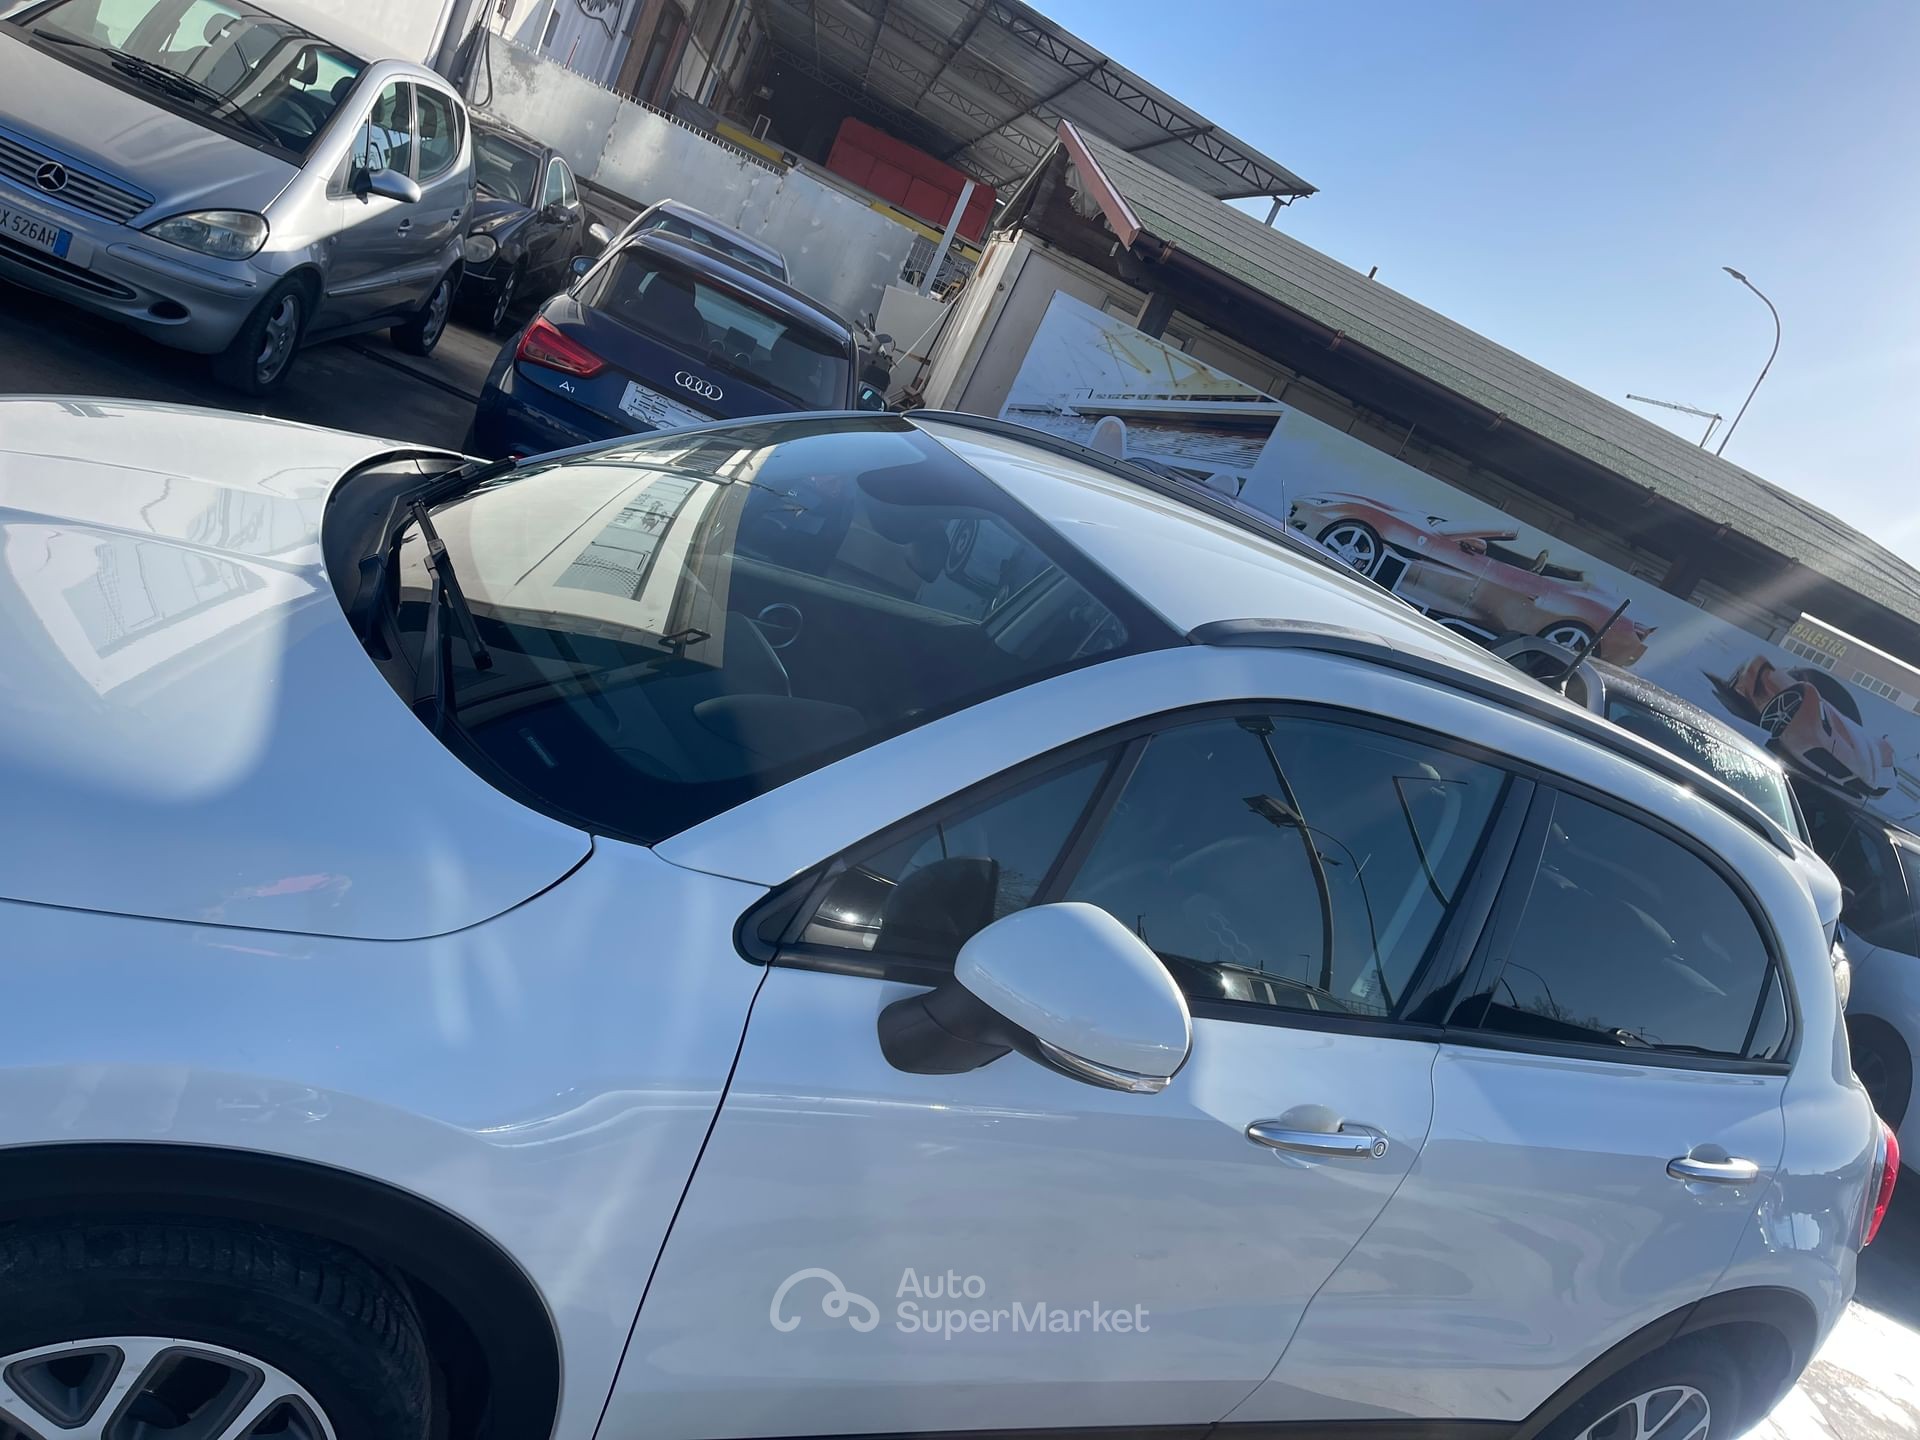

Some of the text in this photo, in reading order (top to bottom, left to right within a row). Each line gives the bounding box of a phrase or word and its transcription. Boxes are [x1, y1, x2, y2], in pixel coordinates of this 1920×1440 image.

[0, 208, 57, 248] X 526AH
[559, 380, 576, 393] A1
[1791, 623, 1848, 657] PALESTRA
